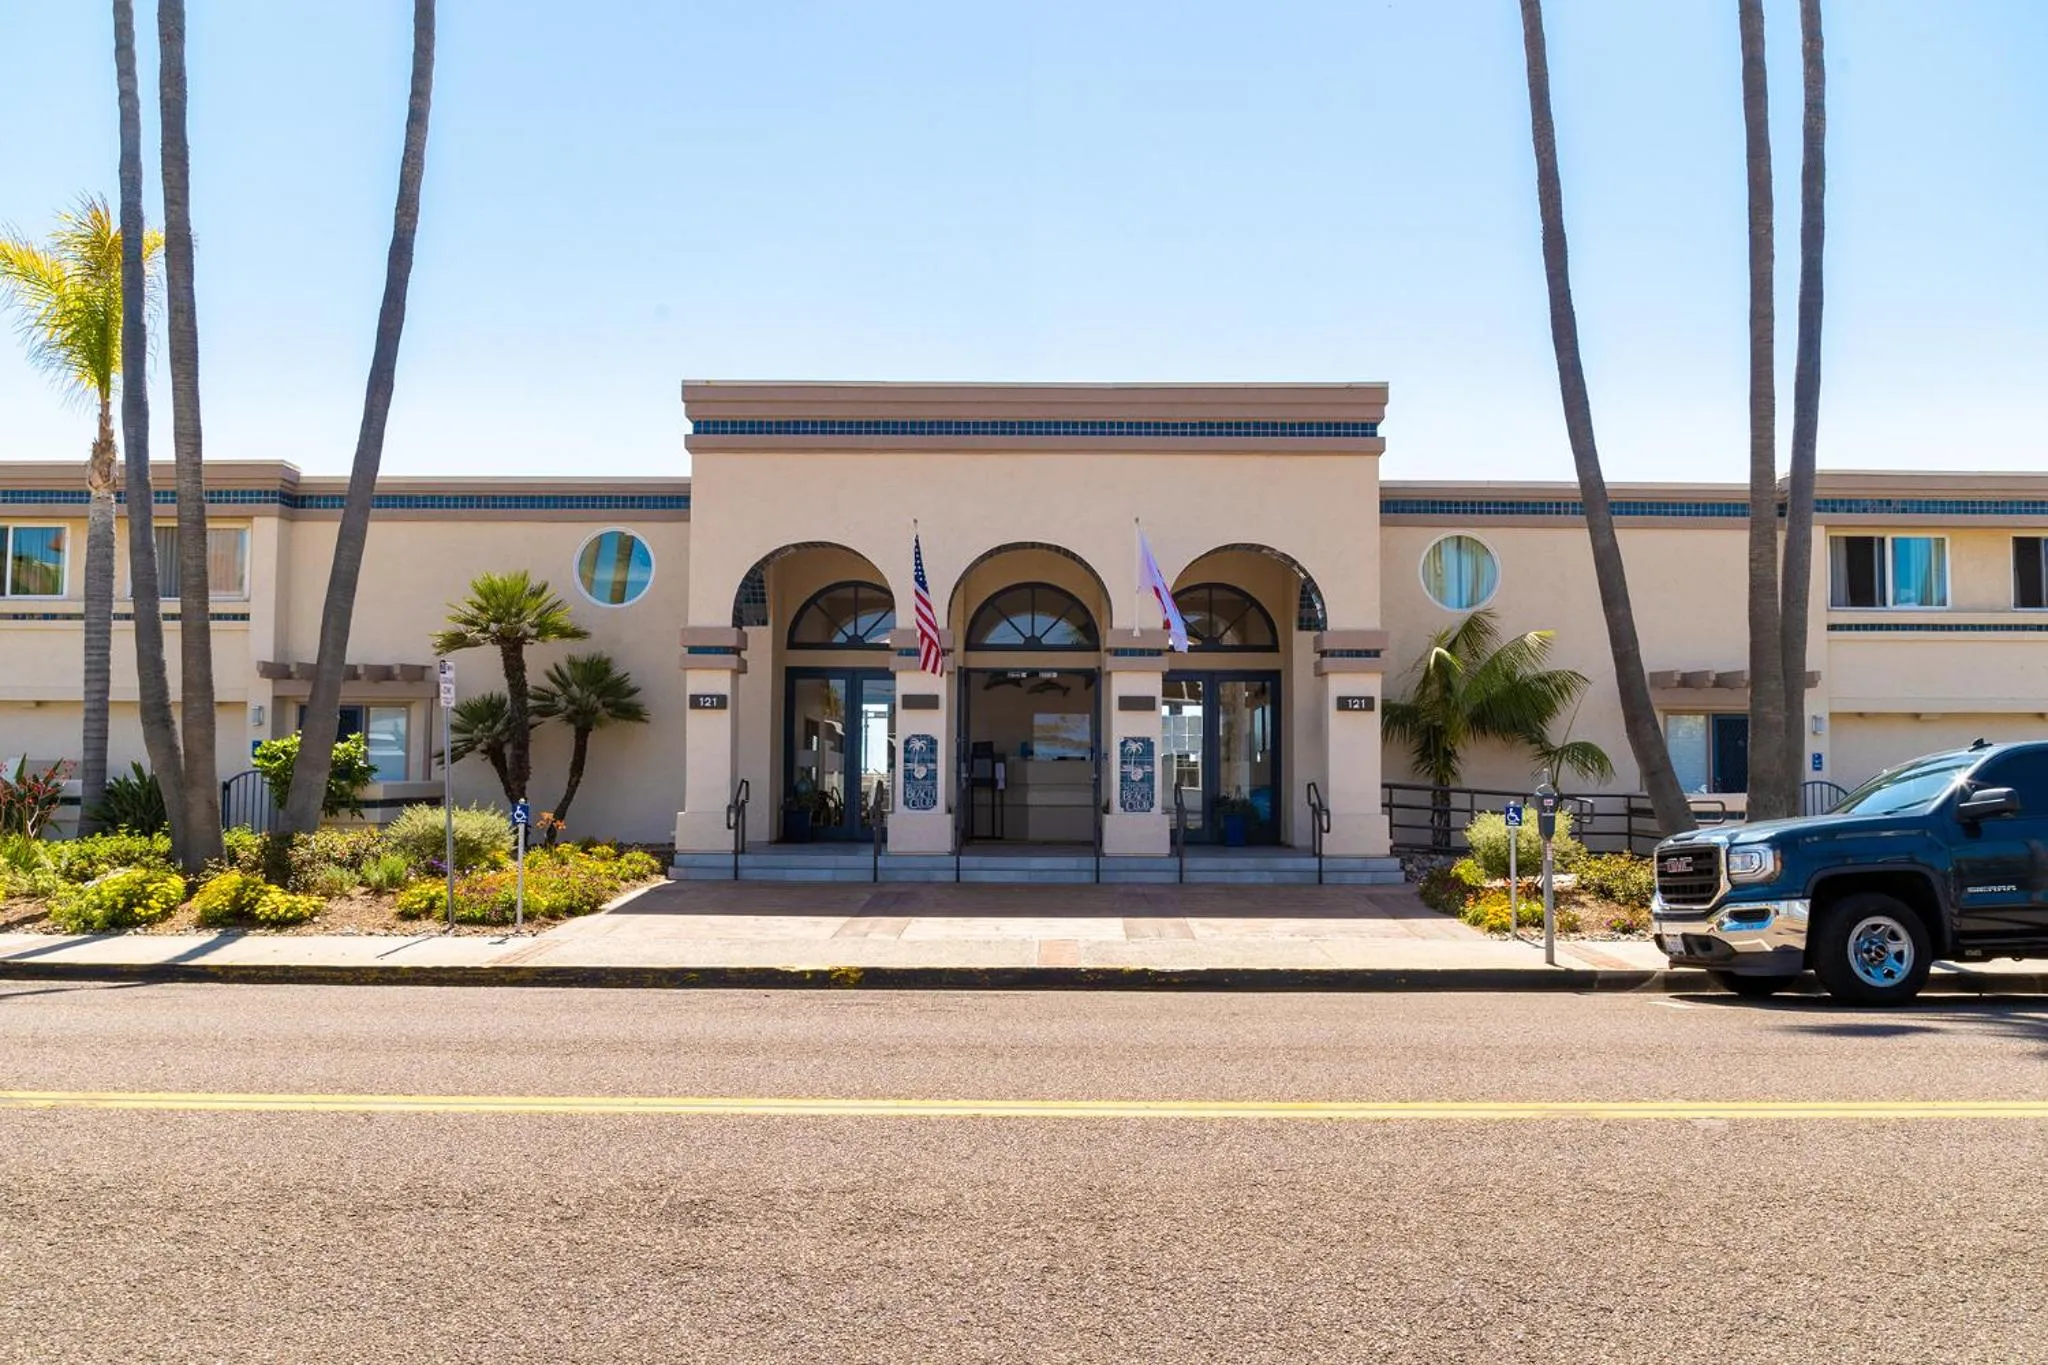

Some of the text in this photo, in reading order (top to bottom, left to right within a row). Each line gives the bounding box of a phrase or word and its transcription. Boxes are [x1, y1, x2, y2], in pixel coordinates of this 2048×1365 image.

[699, 697, 717, 707] 121
[1348, 698, 1365, 709] 121
[906, 787, 936, 799] BEACH
[1665, 856, 1693, 873] GMC
[1967, 885, 2017, 893] SIERRA
